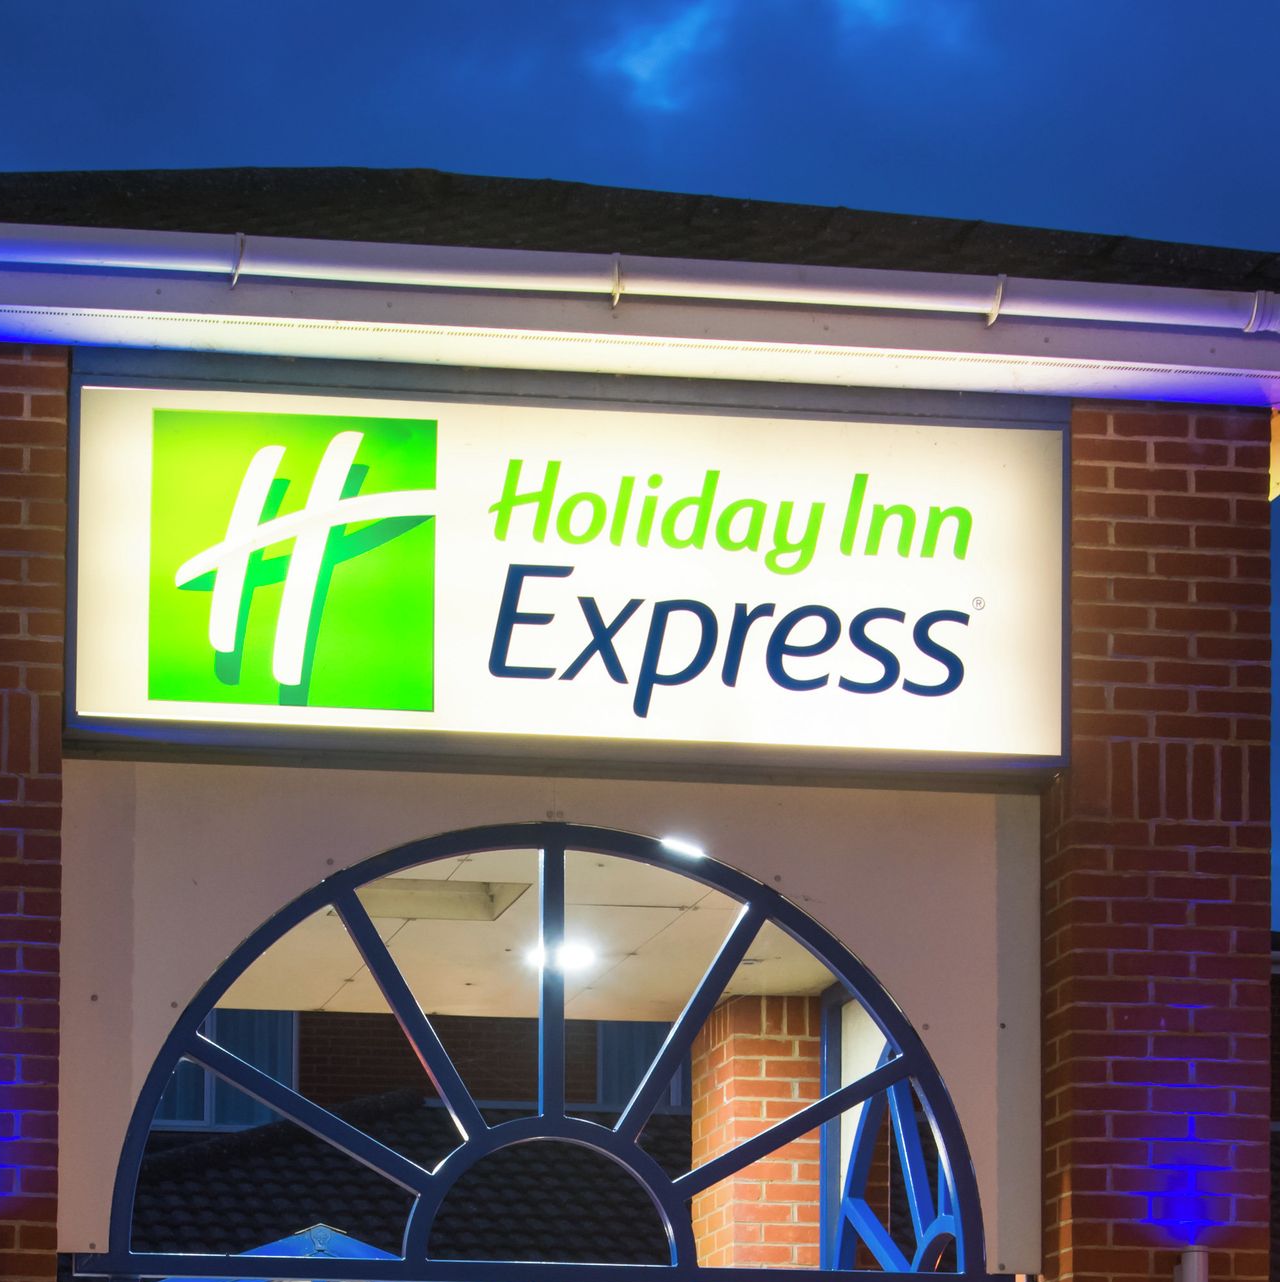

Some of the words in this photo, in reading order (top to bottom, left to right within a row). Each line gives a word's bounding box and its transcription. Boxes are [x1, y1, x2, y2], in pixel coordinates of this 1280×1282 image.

[488, 458, 824, 575] Holiday
[840, 473, 973, 560] Inn
[488, 564, 971, 719] Express
